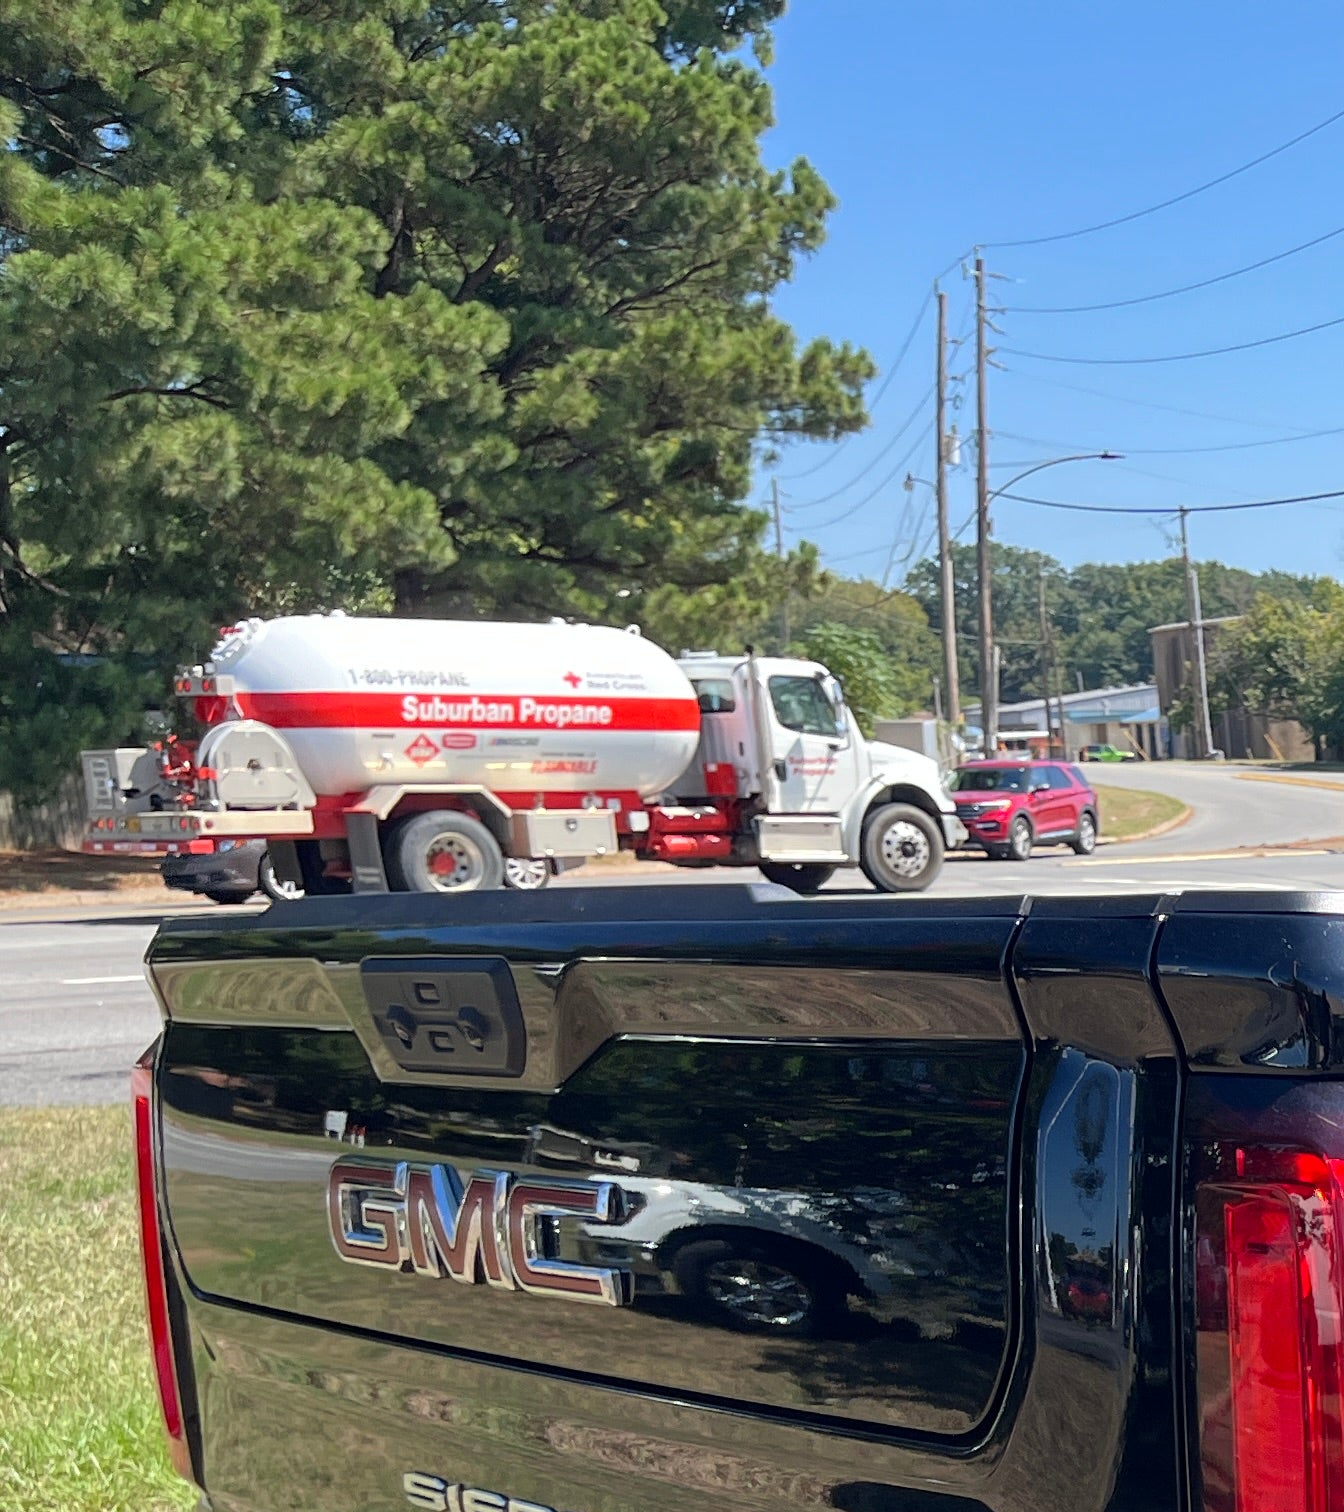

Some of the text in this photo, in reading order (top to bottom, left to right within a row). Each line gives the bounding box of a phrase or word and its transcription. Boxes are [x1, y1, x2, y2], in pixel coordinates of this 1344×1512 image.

[348, 669, 470, 688] 1-800-PROPANE
[402, 696, 613, 728] Suburban Propane
[326, 1154, 636, 1307] GMC
